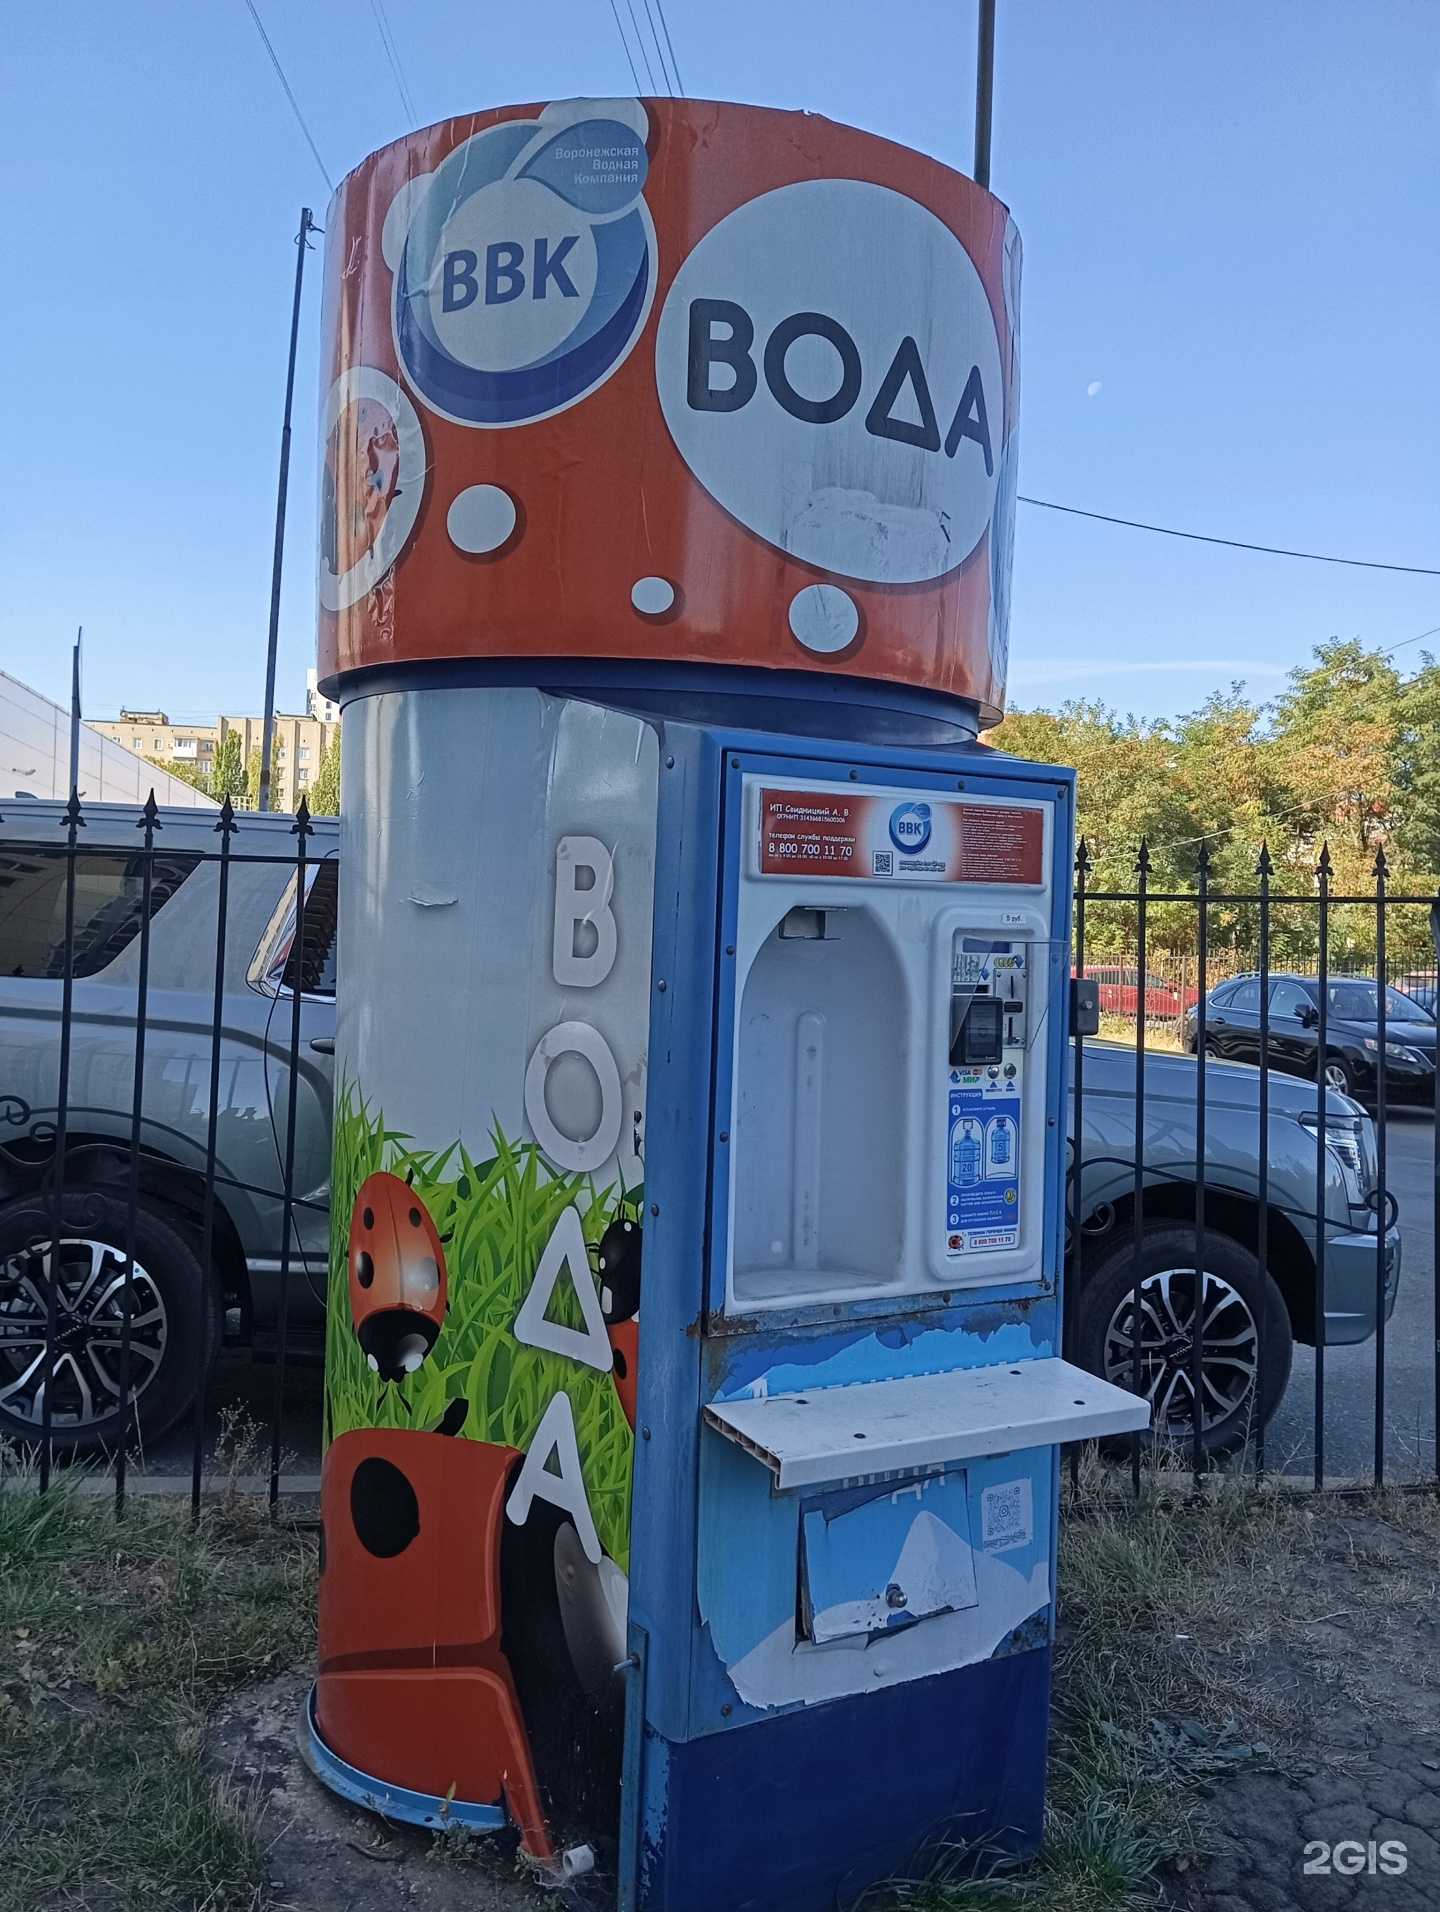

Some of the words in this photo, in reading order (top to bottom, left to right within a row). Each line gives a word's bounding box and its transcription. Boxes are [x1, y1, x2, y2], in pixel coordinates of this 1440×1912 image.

[555, 147, 639, 160] Воронежская
[592, 160, 639, 171] Водная
[574, 173, 638, 185] Компания
[442, 236, 580, 313] ВВК
[687, 298, 994, 477] ВОДА
[769, 803, 783, 812] ИП
[785, 805, 830, 816] Свидницкий
[898, 821, 922, 835] ВВК
[768, 842, 775, 853] 8
[779, 843, 798, 854] 800
[801, 844, 820, 855] 700
[824, 845, 835, 856] 11
[840, 846, 853, 857] 70
